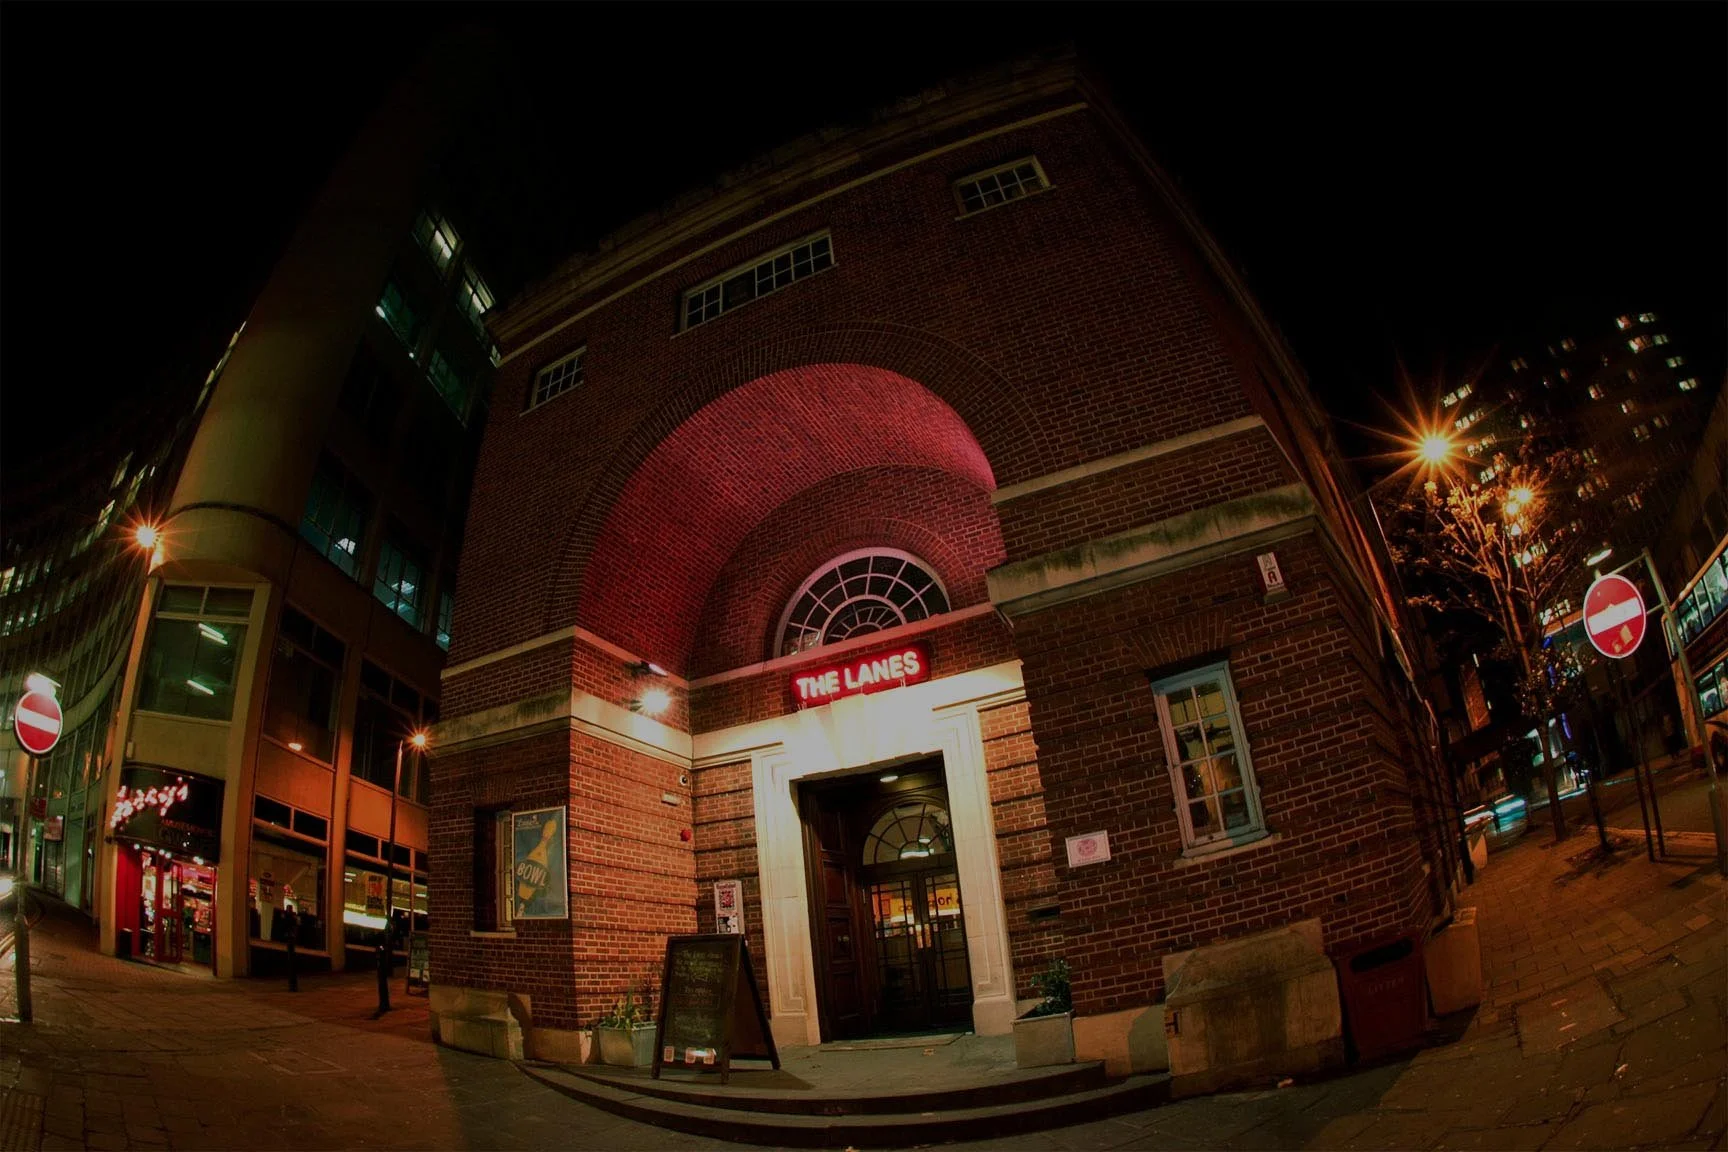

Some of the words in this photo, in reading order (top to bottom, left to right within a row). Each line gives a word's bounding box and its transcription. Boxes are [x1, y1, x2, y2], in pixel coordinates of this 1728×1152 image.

[796, 670, 840, 699] THE
[844, 651, 920, 690] LANES
[516, 862, 546, 887] BOWL
